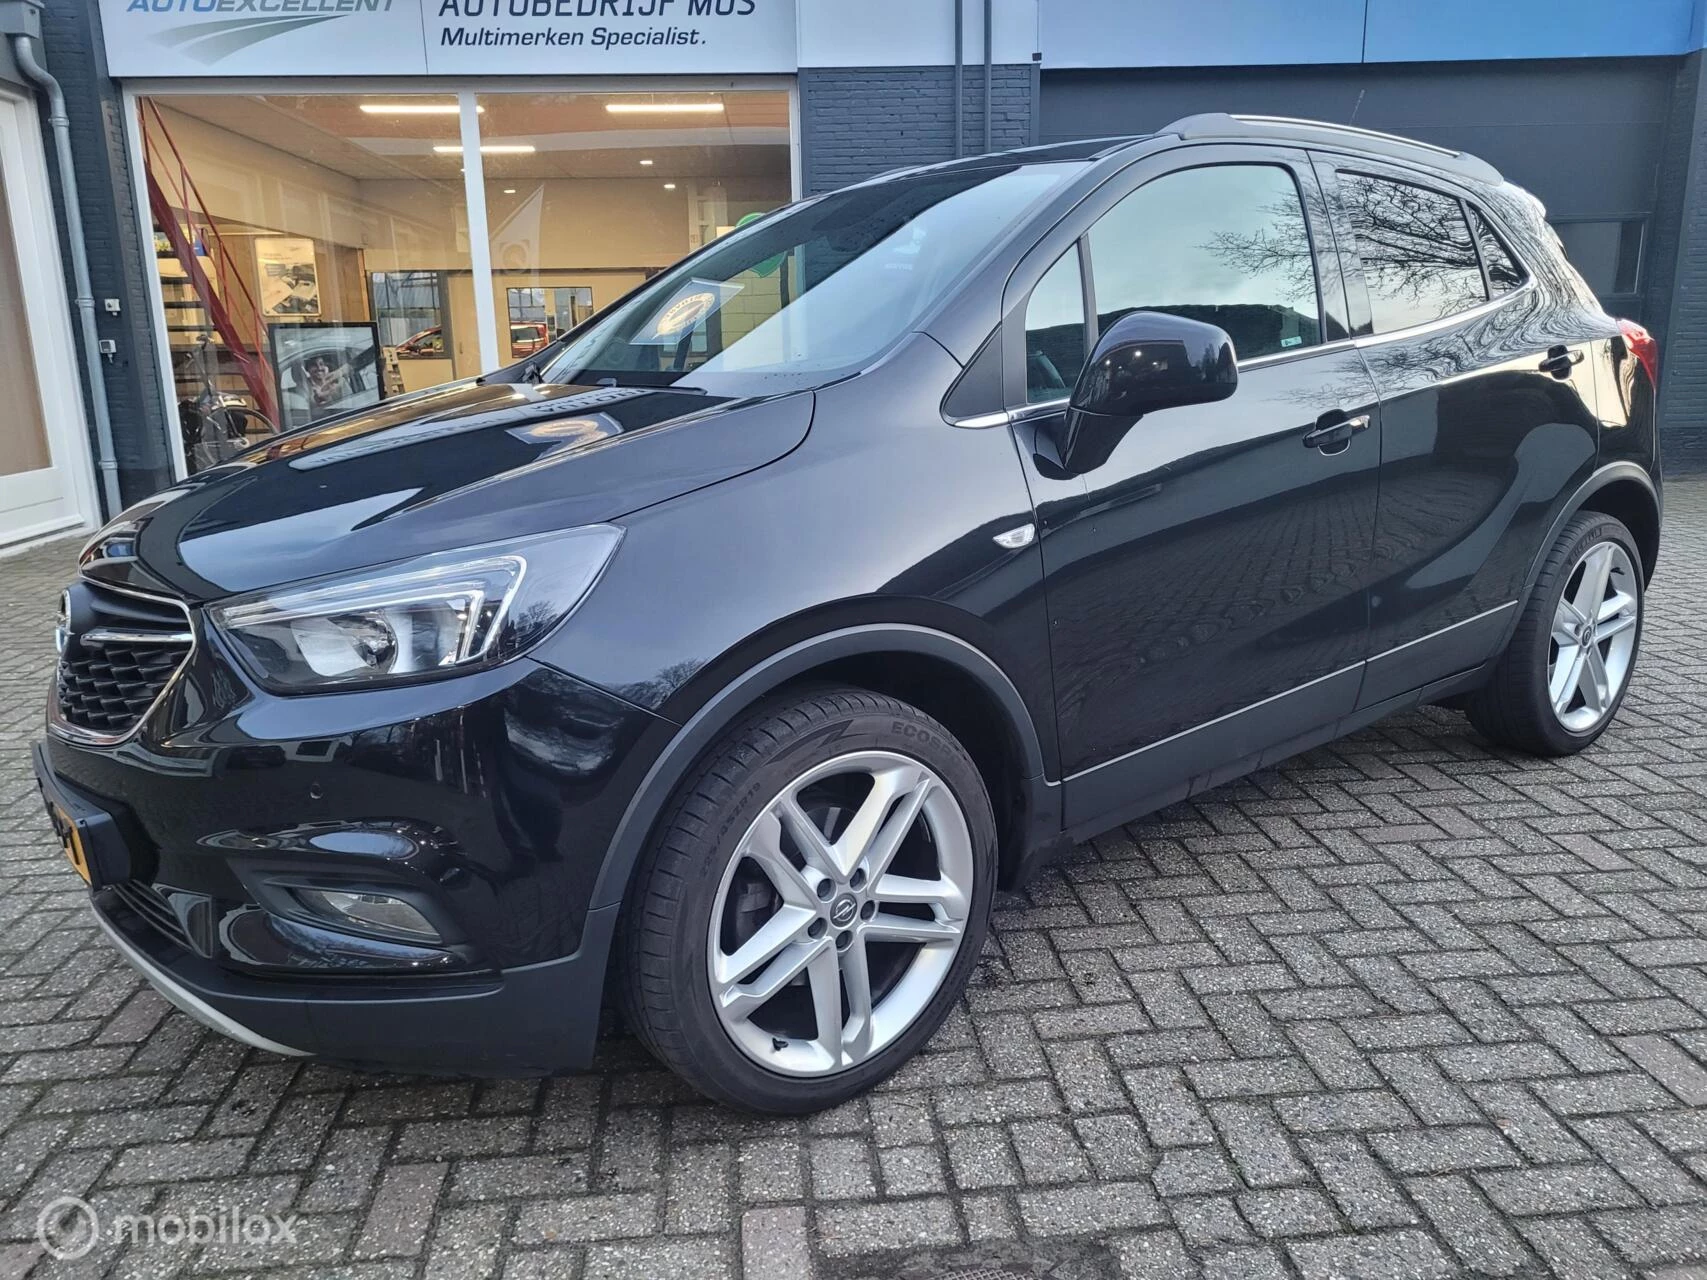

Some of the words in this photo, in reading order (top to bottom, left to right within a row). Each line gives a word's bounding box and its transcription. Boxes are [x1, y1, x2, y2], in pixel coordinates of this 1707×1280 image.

[126, 0, 394, 12] AUTOEXCELLENT
[438, 0, 675, 17] AUTOBEDRIJF
[440, 27, 584, 46] Multimerken
[590, 26, 707, 50] Specialist.
